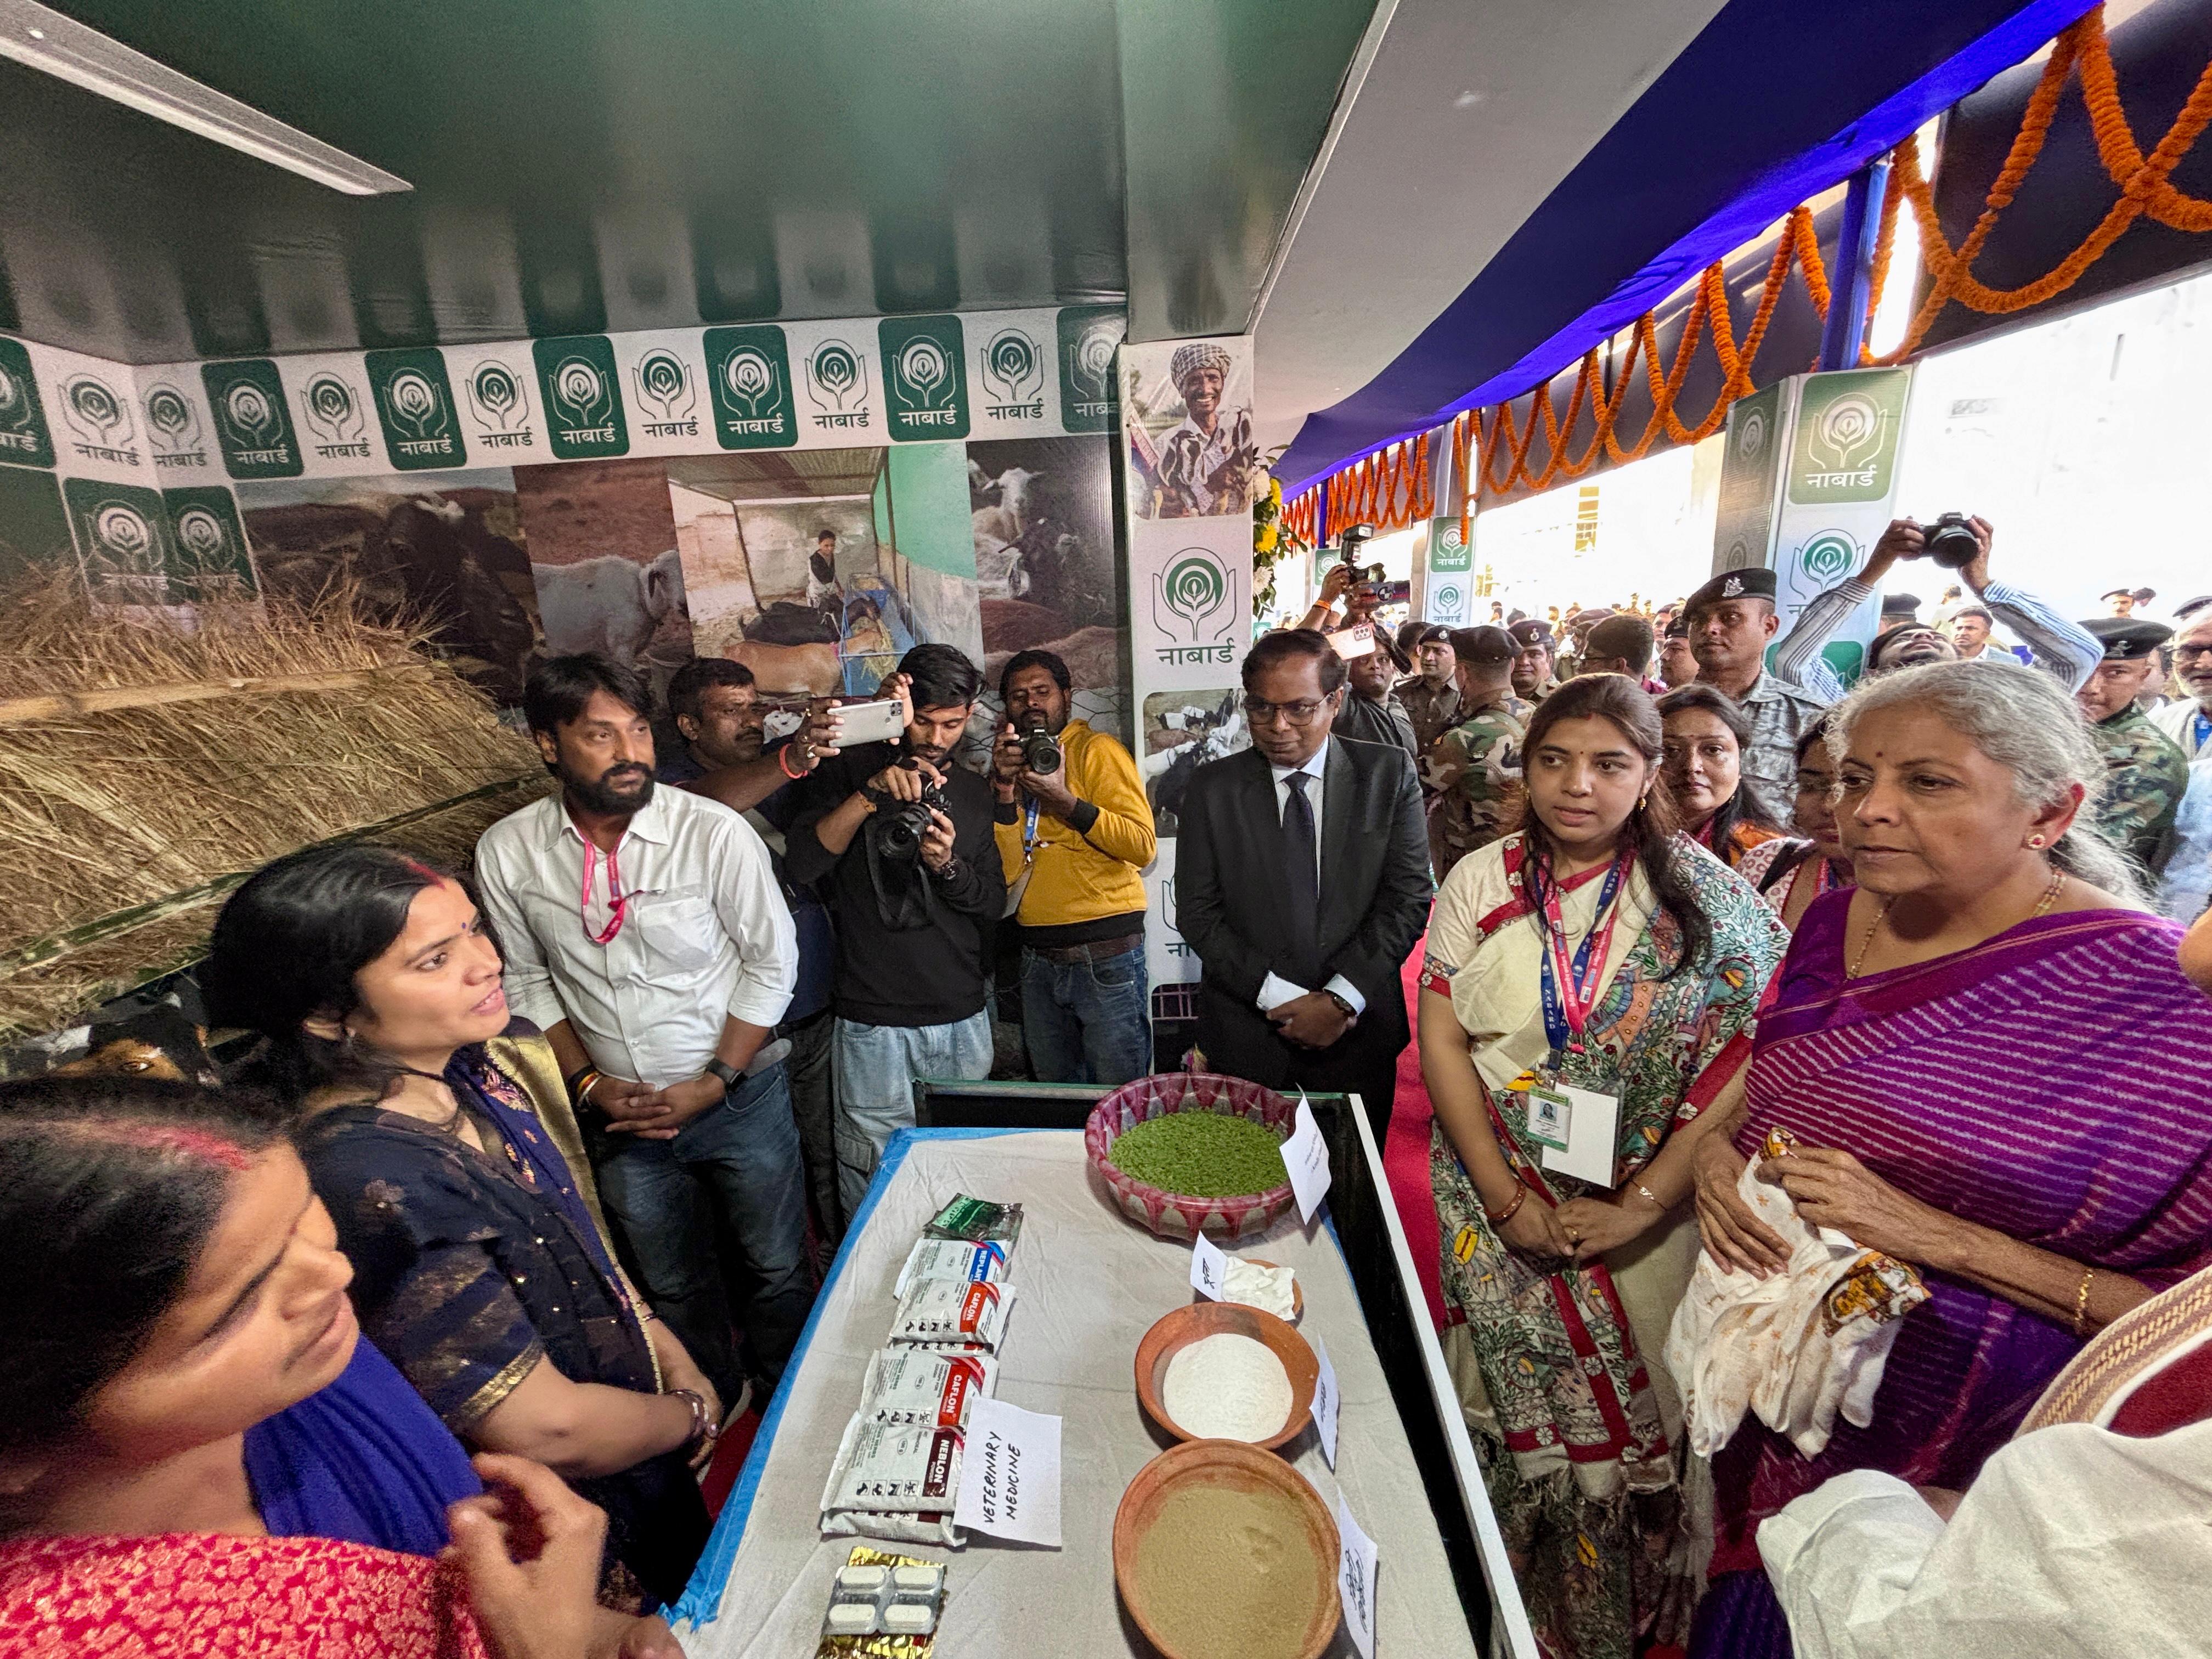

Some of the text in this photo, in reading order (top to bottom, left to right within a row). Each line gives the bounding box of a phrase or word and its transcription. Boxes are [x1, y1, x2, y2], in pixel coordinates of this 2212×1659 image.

[812, 407, 870, 428] नाबार्ड
[899, 405, 957, 426] नाबार्ड
[986, 398, 1043, 420] नाबार्ड
[559, 423, 615, 444] नाबार्ड
[642, 416, 698, 437] नाबार्ड
[728, 413, 784, 435] नाबार्ड
[314, 438, 370, 458] नाबार्ड
[400, 433, 452, 454] नाबार्ड
[478, 427, 533, 447] नाबार्ड
[71, 442, 140, 466] नाबार्ड
[153, 451, 207, 467] नाबार्ड
[234, 443, 289, 465] नाबार्ड
[1805, 465, 1877, 488] नाबार्ड
[1437, 556, 1466, 566] नाबार्ड
[1433, 614, 1462, 624] नाबार्ड
[1155, 637, 1235, 665] नाबार्ड
[1545, 989, 1555, 1029] NABARD
[966, 1292, 981, 1321] CAFLON
[946, 1374, 962, 1414] CAFLON
[934, 1440, 950, 1483] NEBLON
[984, 1431, 1002, 1523] VETERINARY
[1006, 1444, 1021, 1520] MEDICINE
